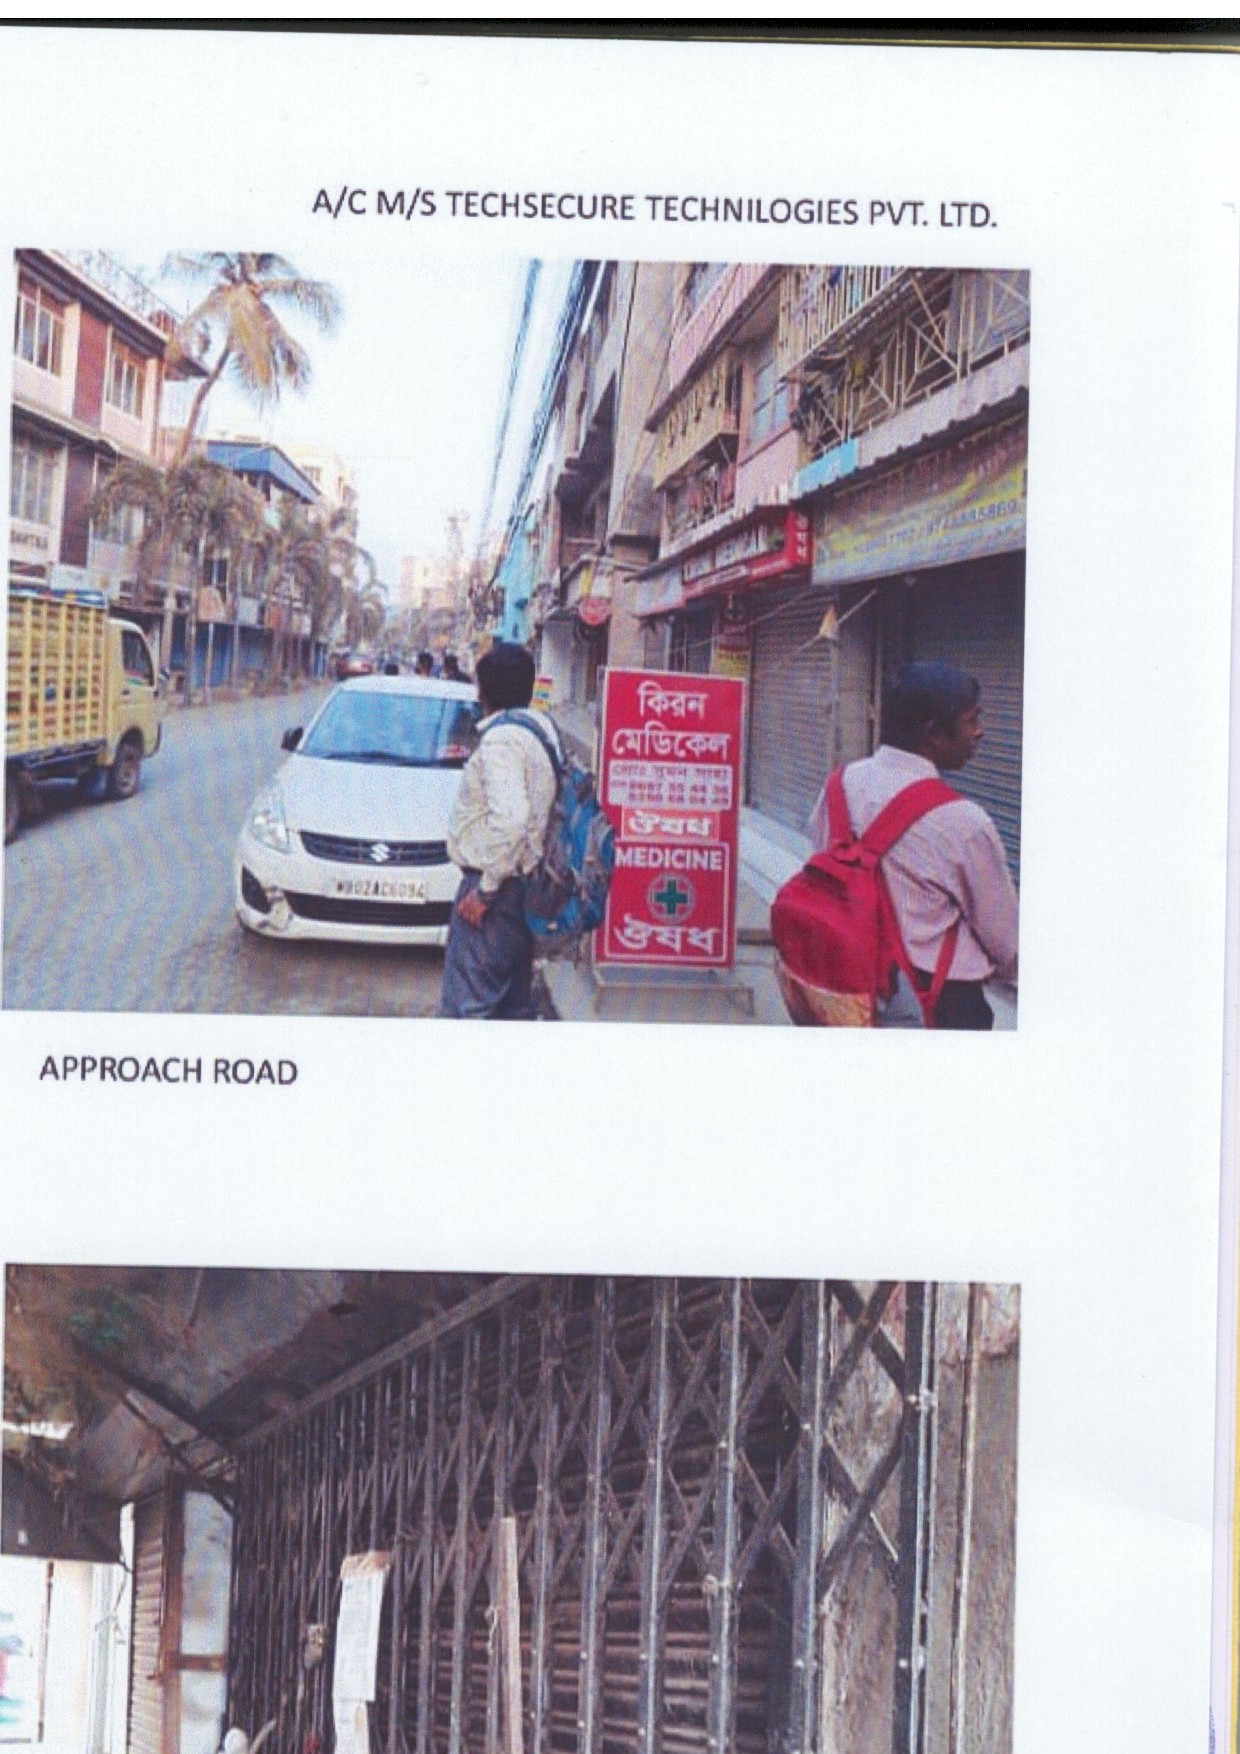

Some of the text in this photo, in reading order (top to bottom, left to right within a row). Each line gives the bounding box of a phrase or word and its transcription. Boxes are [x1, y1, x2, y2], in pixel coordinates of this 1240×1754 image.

[312, 186, 997, 228] A/C M/S TECHSECURE TECHNILOGIES PVT. LTD.
[612, 721, 731, 761] মেডিকেল
[615, 847, 723, 870] MEDICINE
[614, 912, 720, 955] ঔষধ
[39, 1055, 298, 1085] APPROACH ROAD
